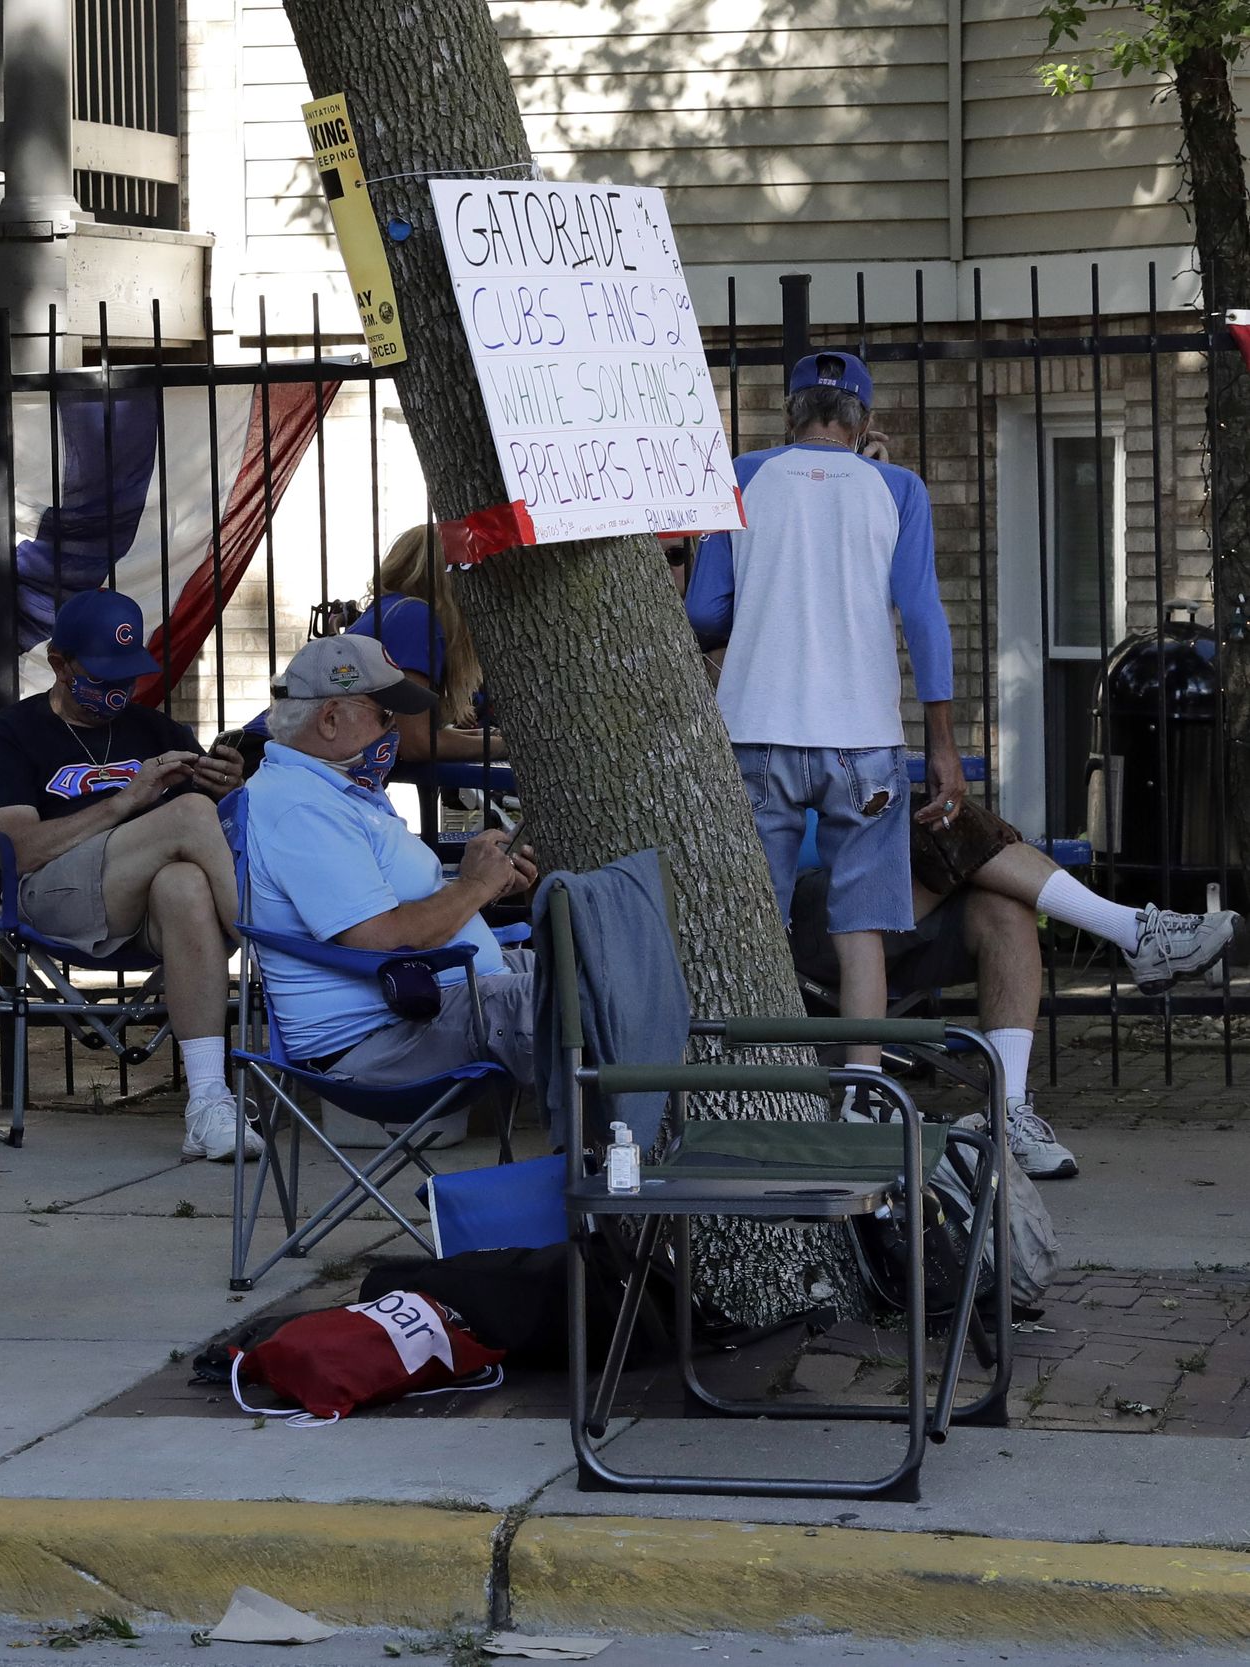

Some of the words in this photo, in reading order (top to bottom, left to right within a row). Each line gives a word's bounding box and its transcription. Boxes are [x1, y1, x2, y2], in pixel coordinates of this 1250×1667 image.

[317, 148, 356, 167] EEPING
[456, 191, 637, 271] GATORADE
[634, 197, 683, 278] WATER
[357, 290, 372, 309] AY
[472, 286, 566, 350] CUBS
[579, 282, 656, 346] FANS
[487, 363, 573, 425] WHITE
[576, 361, 635, 424] SOX
[631, 362, 685, 427] FANS
[509, 440, 634, 507] BREWERS
[636, 437, 696, 498] FANS
[786, 469, 810, 479] SHAKE
[825, 472, 851, 480] SHACK
[115, 623, 134, 646] C
